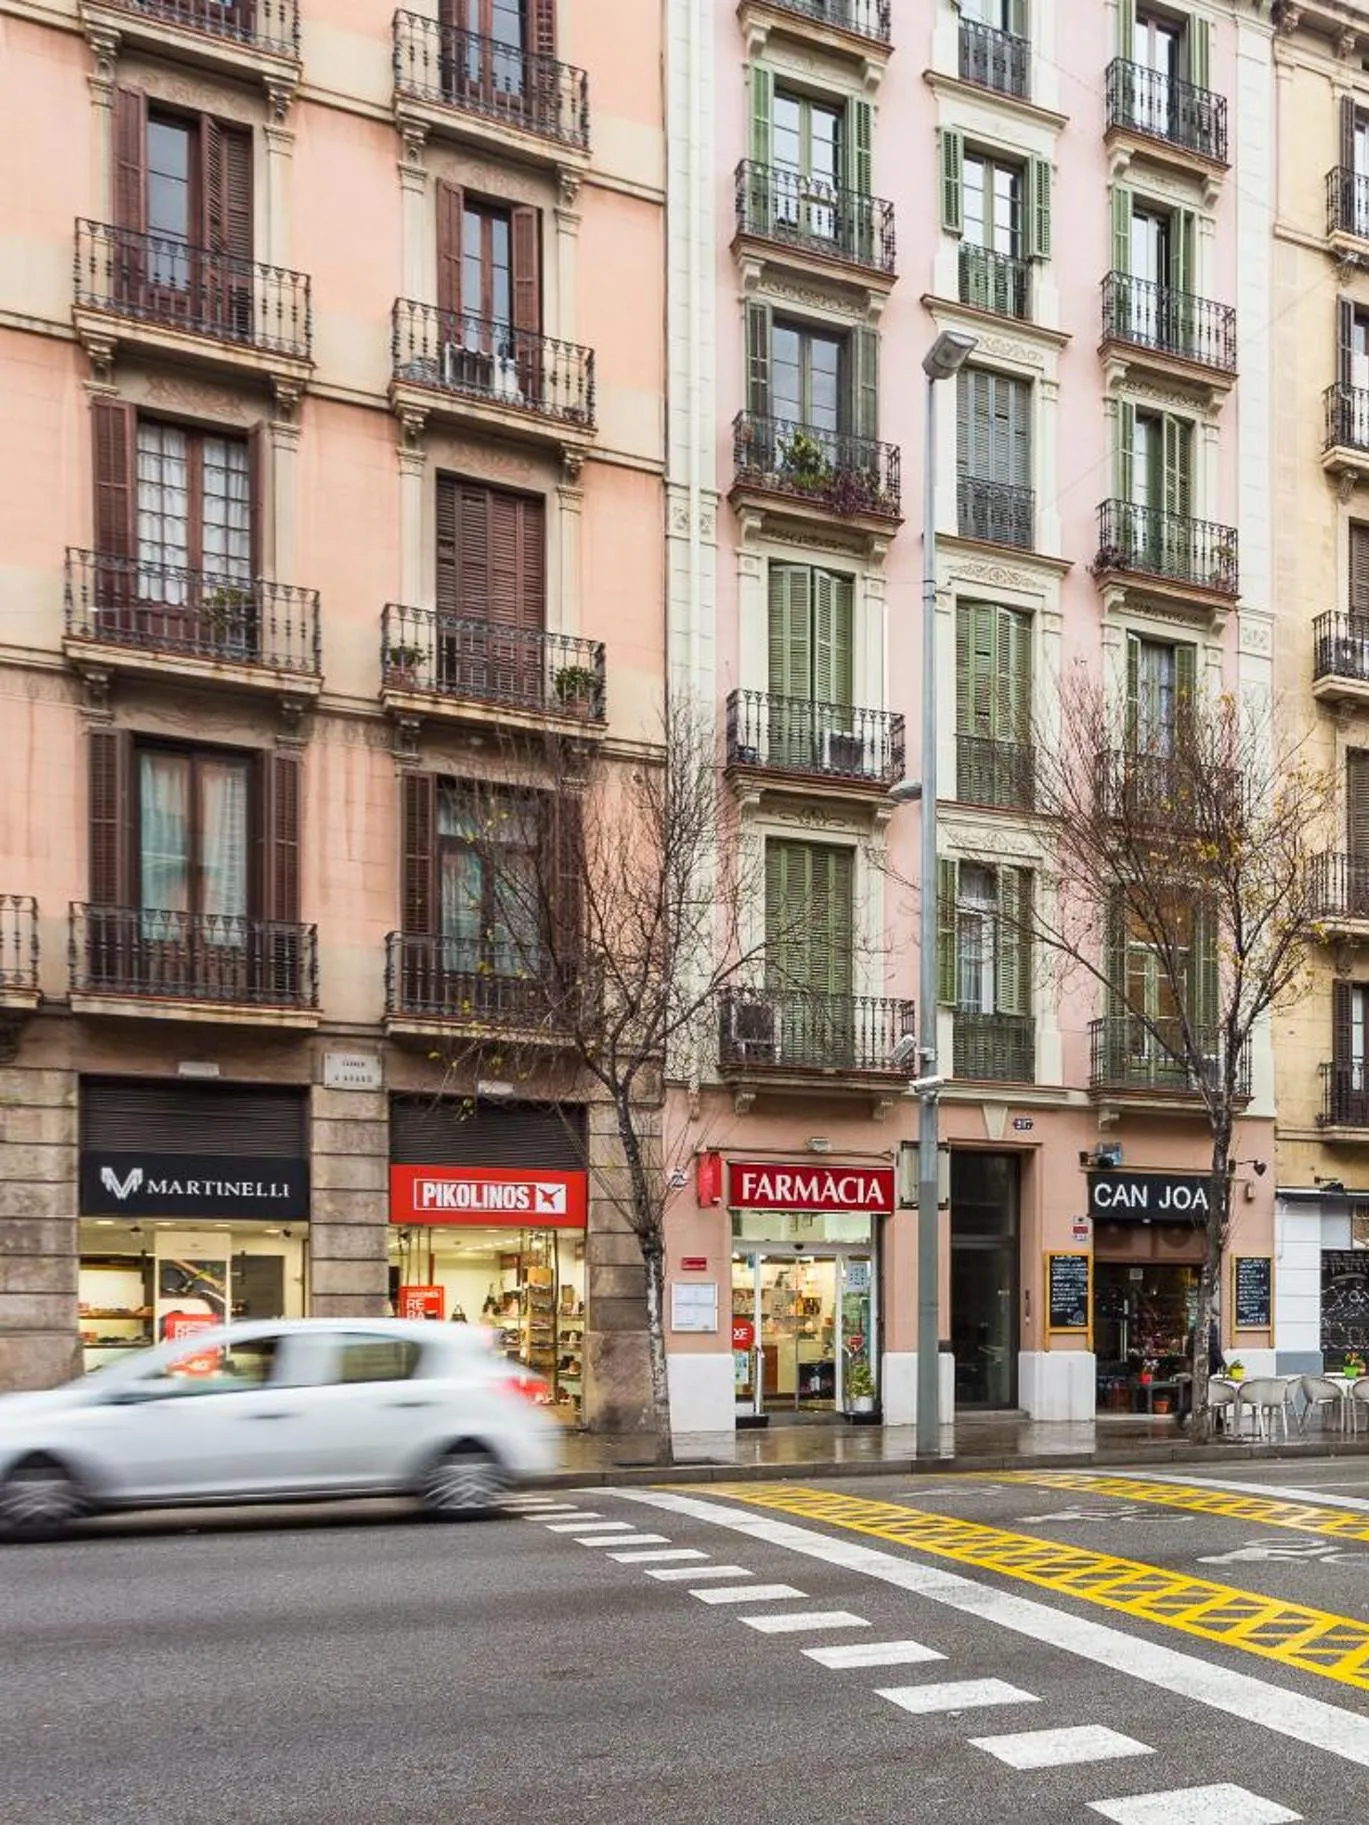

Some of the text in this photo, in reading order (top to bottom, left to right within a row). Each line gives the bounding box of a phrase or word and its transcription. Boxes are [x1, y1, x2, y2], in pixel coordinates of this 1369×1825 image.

[147, 1179, 291, 1198] MARTINELLI
[422, 1182, 530, 1210] PIKOLINOS
[741, 1171, 885, 1205] FARMÀCIA
[1094, 1183, 1226, 1211] CAN JOA
